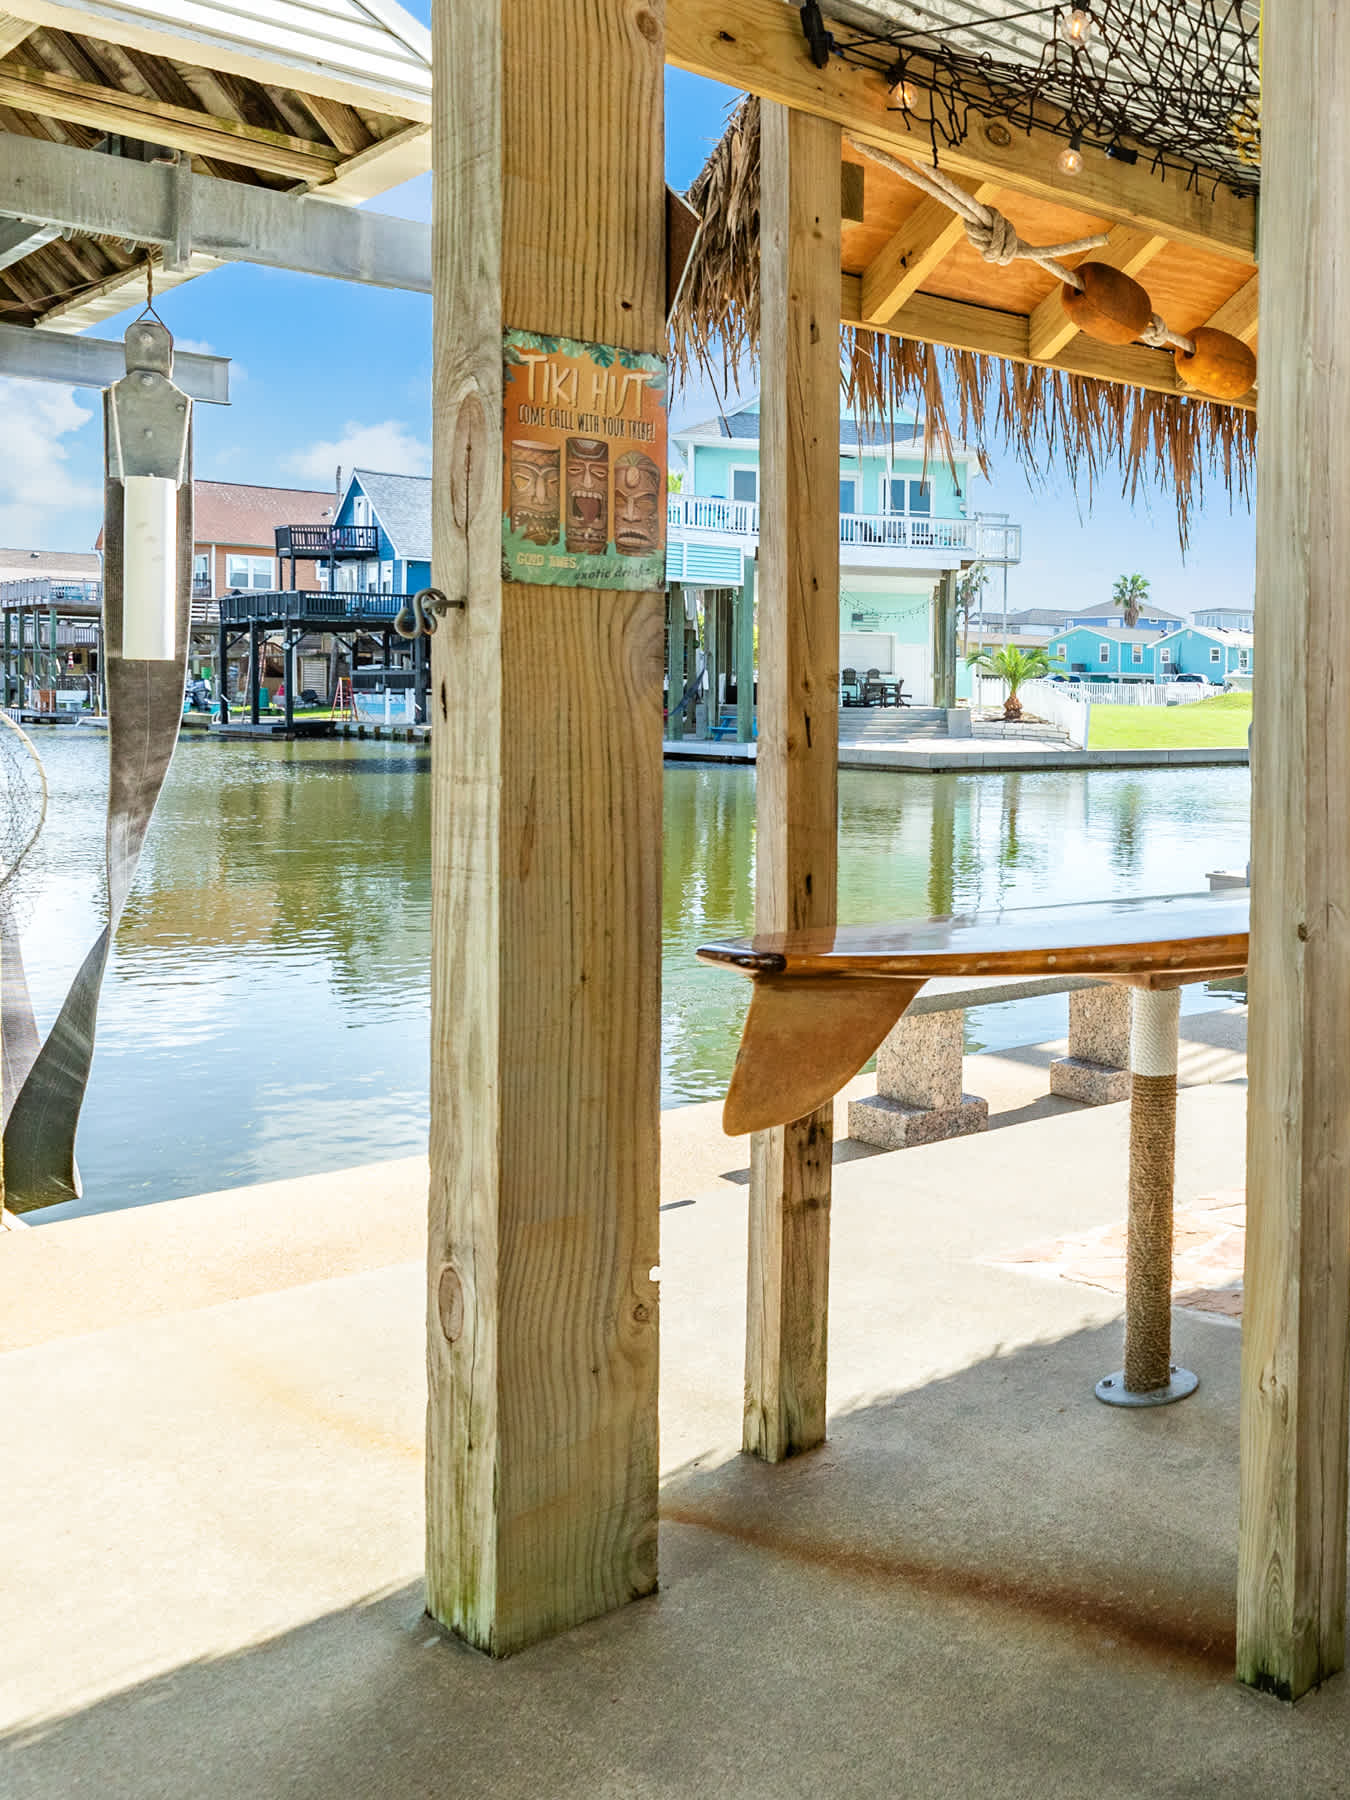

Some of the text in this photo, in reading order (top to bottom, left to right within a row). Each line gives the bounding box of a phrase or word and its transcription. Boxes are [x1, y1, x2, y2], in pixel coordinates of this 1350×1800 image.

[518, 354, 653, 417] TIKI HUT
[519, 404, 656, 442] COME CHILL WITH YOUR TRIBE!
[574, 568, 611, 580] exotic
